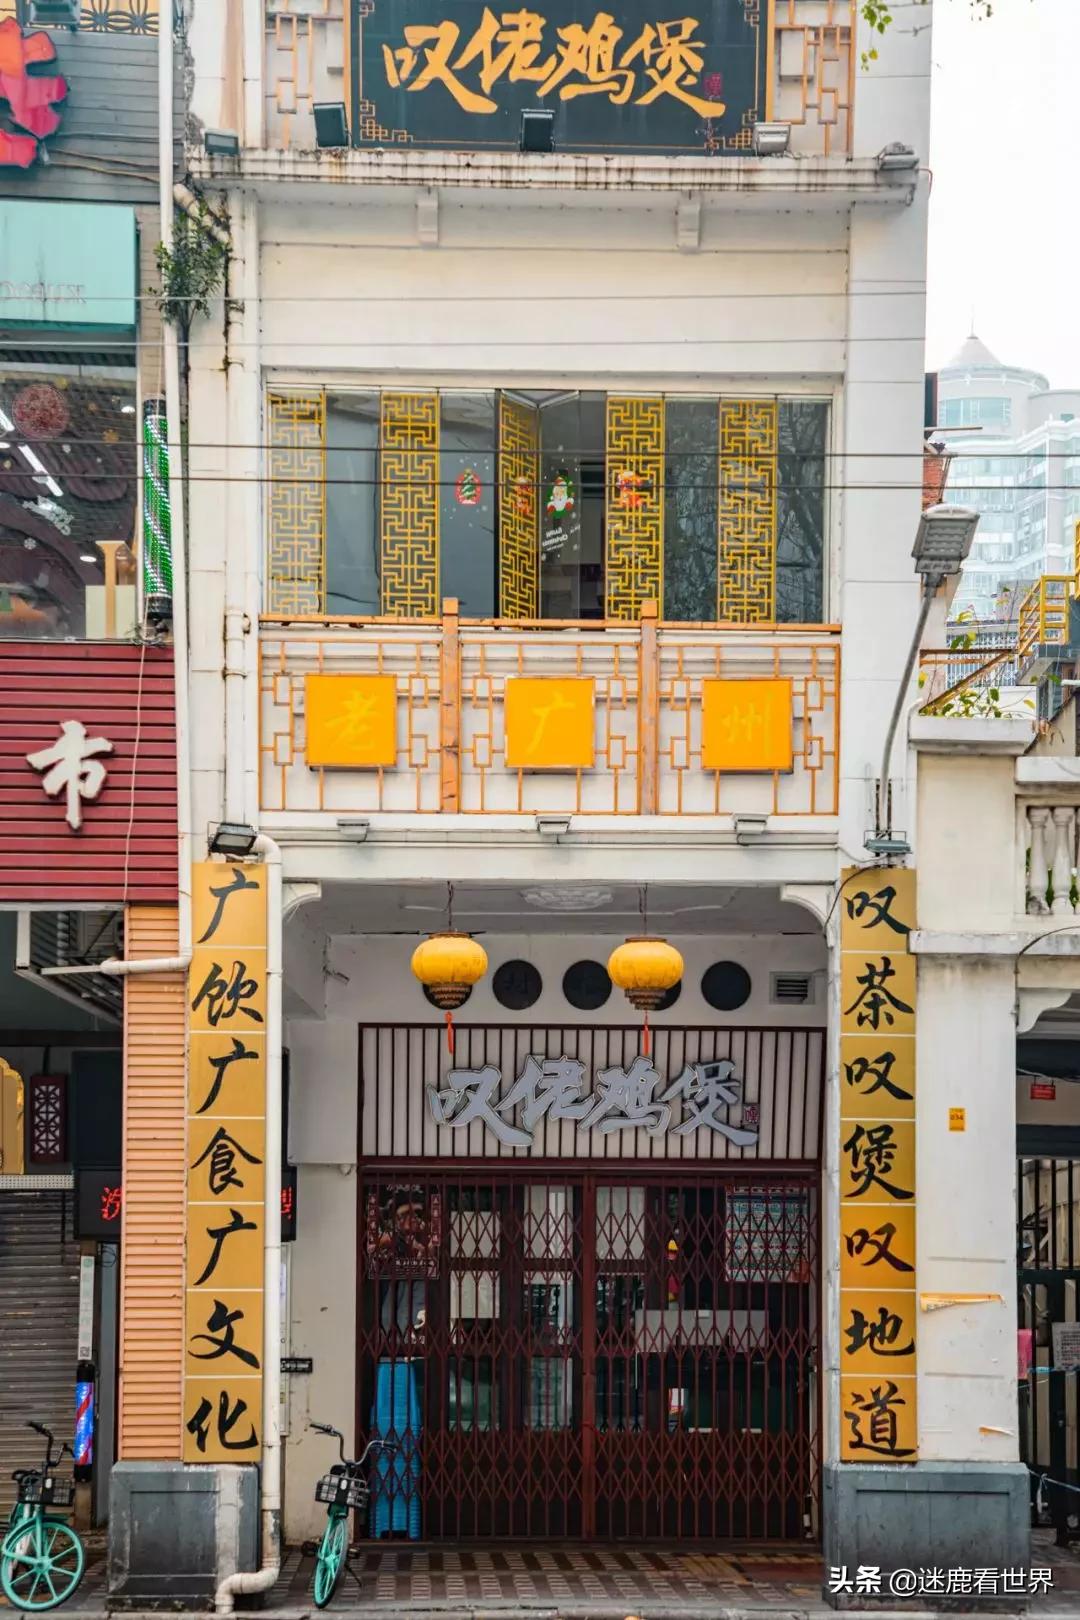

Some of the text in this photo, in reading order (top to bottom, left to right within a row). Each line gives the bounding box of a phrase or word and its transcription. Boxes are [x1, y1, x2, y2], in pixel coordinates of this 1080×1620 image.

[382, 6, 726, 118] 叹佬鸡煲
[27, 719, 113, 829] 市
[325, 690, 774, 758] 老广州
[427, 1054, 759, 1147] 叹佬鸡煲
[187, 867, 264, 1453] 广饮广食广文化
[844, 886, 916, 1457] 叹茶叹煲叹地道
